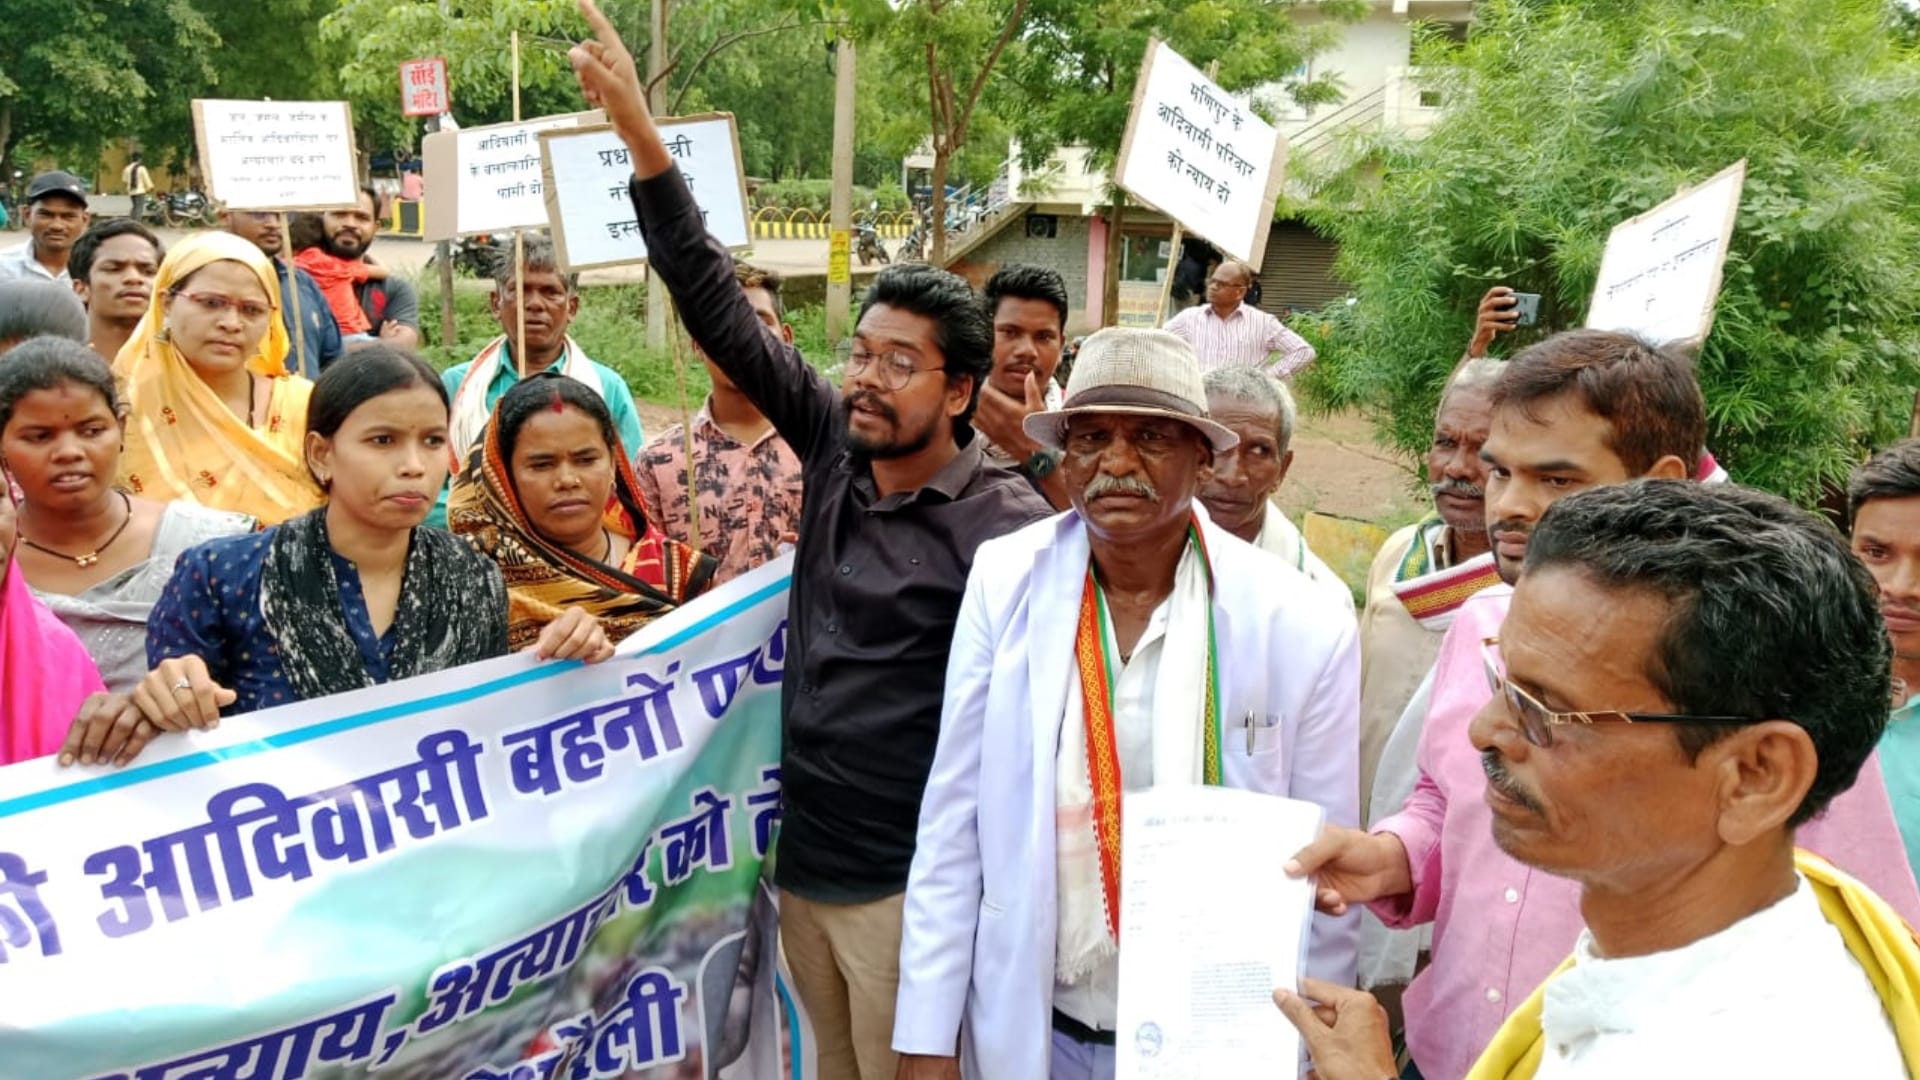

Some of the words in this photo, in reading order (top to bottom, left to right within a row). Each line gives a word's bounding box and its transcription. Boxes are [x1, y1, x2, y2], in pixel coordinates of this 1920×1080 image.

[1190, 82, 1230, 125] मणिपुर
[477, 129, 528, 151] आदिवासी
[1157, 101, 1214, 152] आदिवासी
[1216, 141, 1257, 178] परिवार
[1167, 147, 1185, 175] को
[1186, 162, 1216, 194] न्याय
[1217, 180, 1232, 205] दो
[83, 729, 489, 938] आदिवासी
[502, 660, 684, 796] बहनों
[660, 790, 731, 882] को
